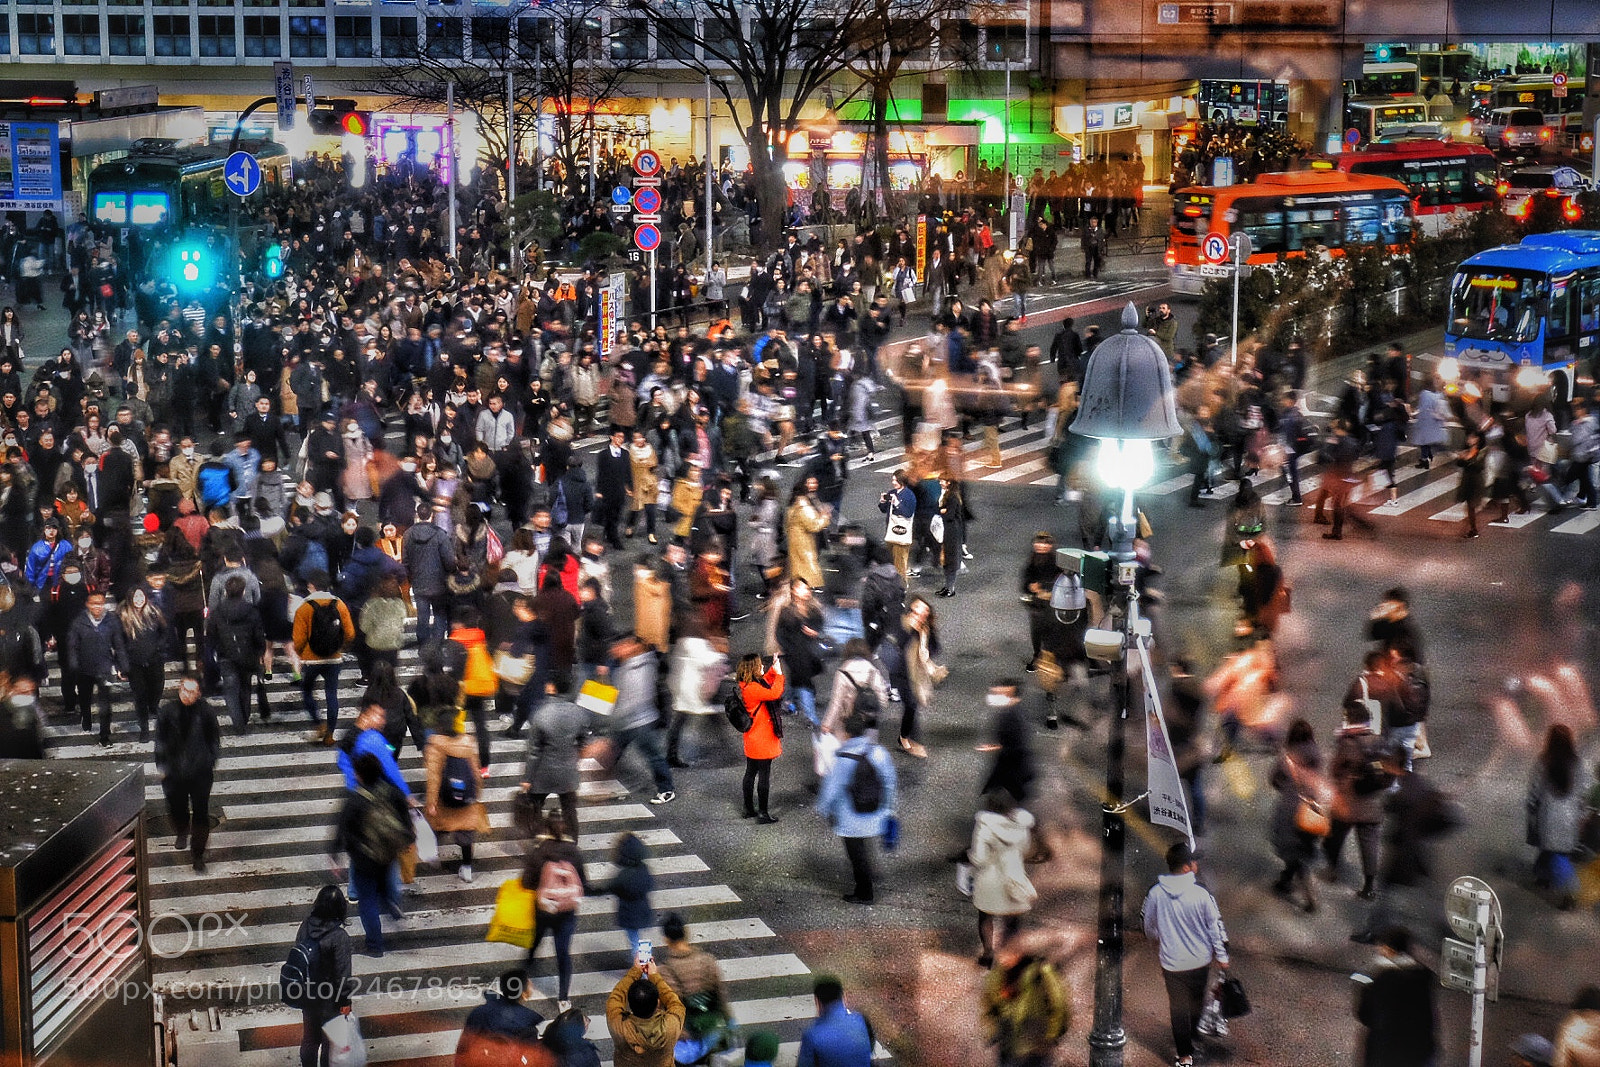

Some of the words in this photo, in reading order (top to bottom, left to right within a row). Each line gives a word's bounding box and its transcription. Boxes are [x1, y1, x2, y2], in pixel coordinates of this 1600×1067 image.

[629, 252, 640, 261] 16
[1202, 267, 1227, 276] ここまで
